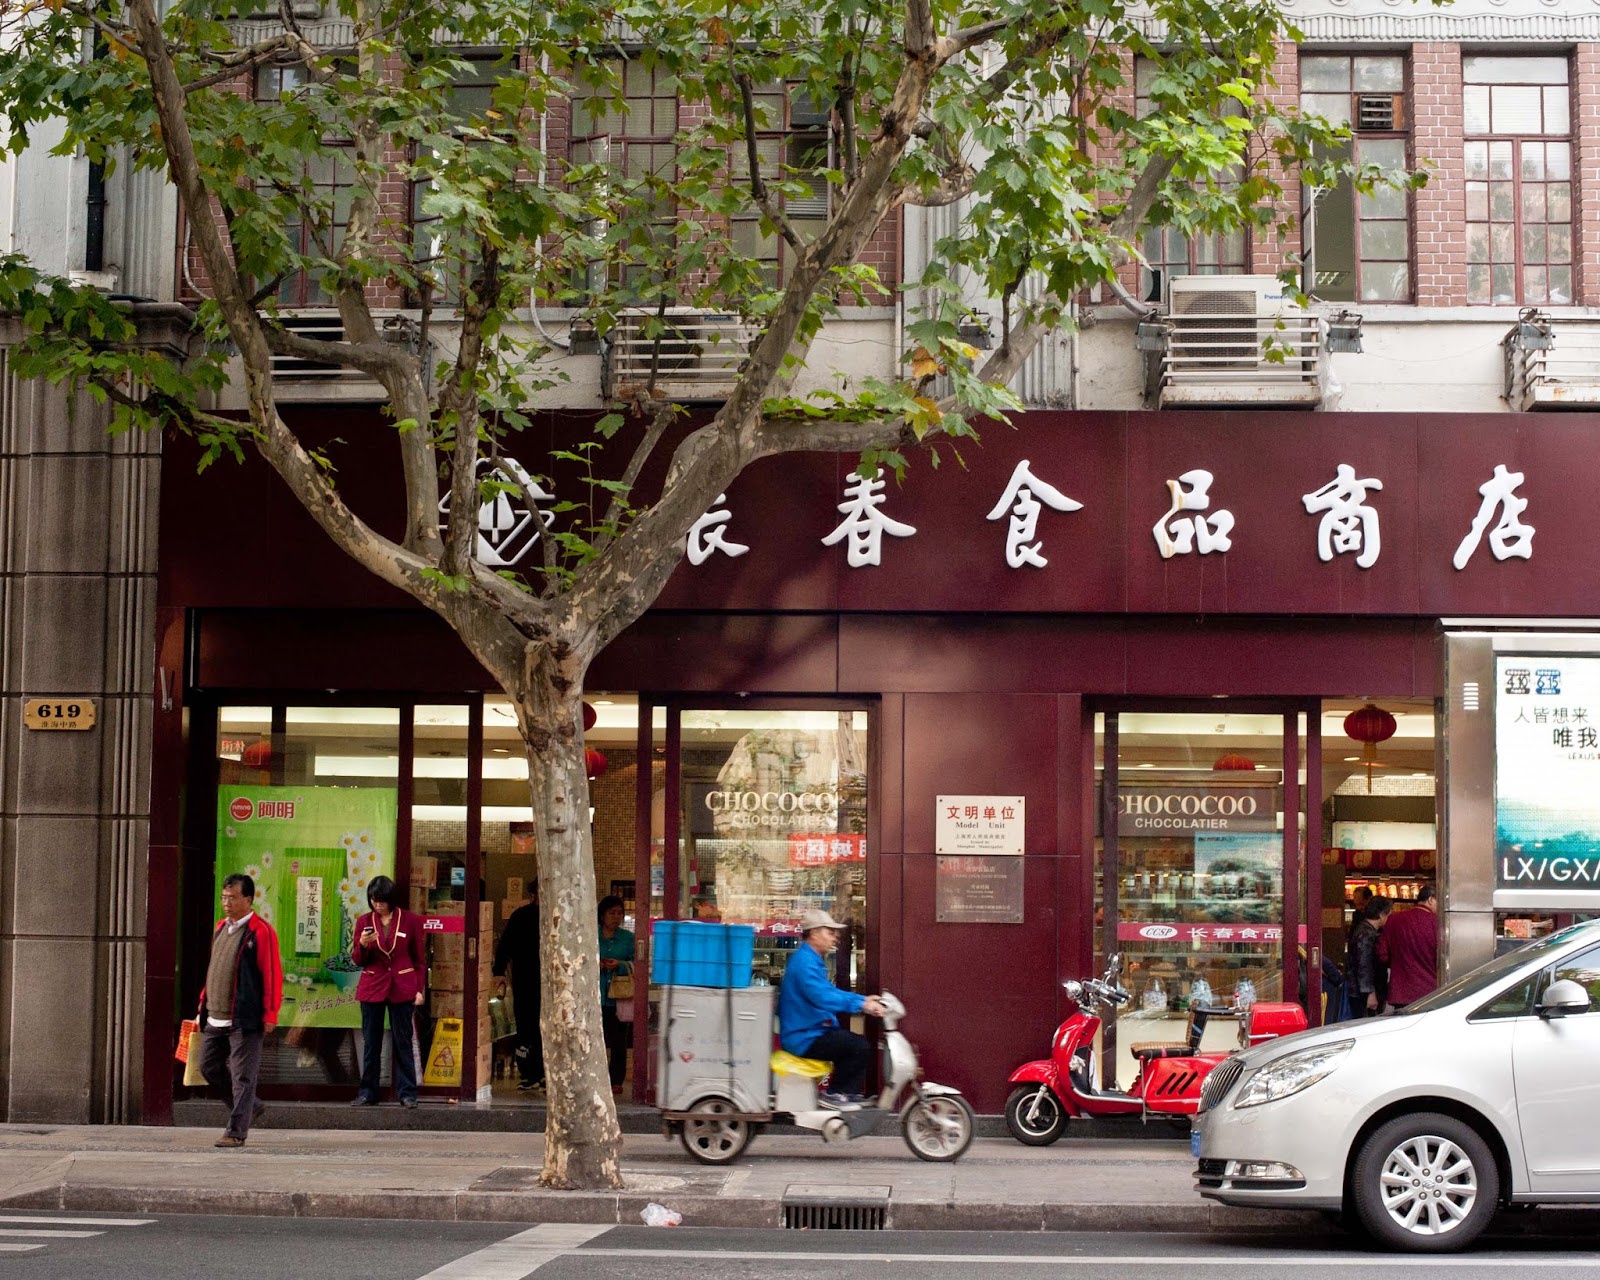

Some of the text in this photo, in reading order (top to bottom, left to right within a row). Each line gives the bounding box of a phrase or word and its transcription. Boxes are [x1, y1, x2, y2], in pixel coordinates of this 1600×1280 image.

[38, 704, 81, 718] 619
[1514, 706, 1589, 724] 人皆想来
[1553, 727, 1599, 749] 唯我
[258, 801, 295, 819] 阿明
[947, 806, 1015, 820] 文明单位
[955, 821, 979, 829] Model
[1134, 818, 1229, 829] CHOCOLATIER
[306, 880, 319, 940] 菊花香瓜子
[423, 919, 443, 929] 品
[1145, 927, 1283, 939] CCSP 长春食品
